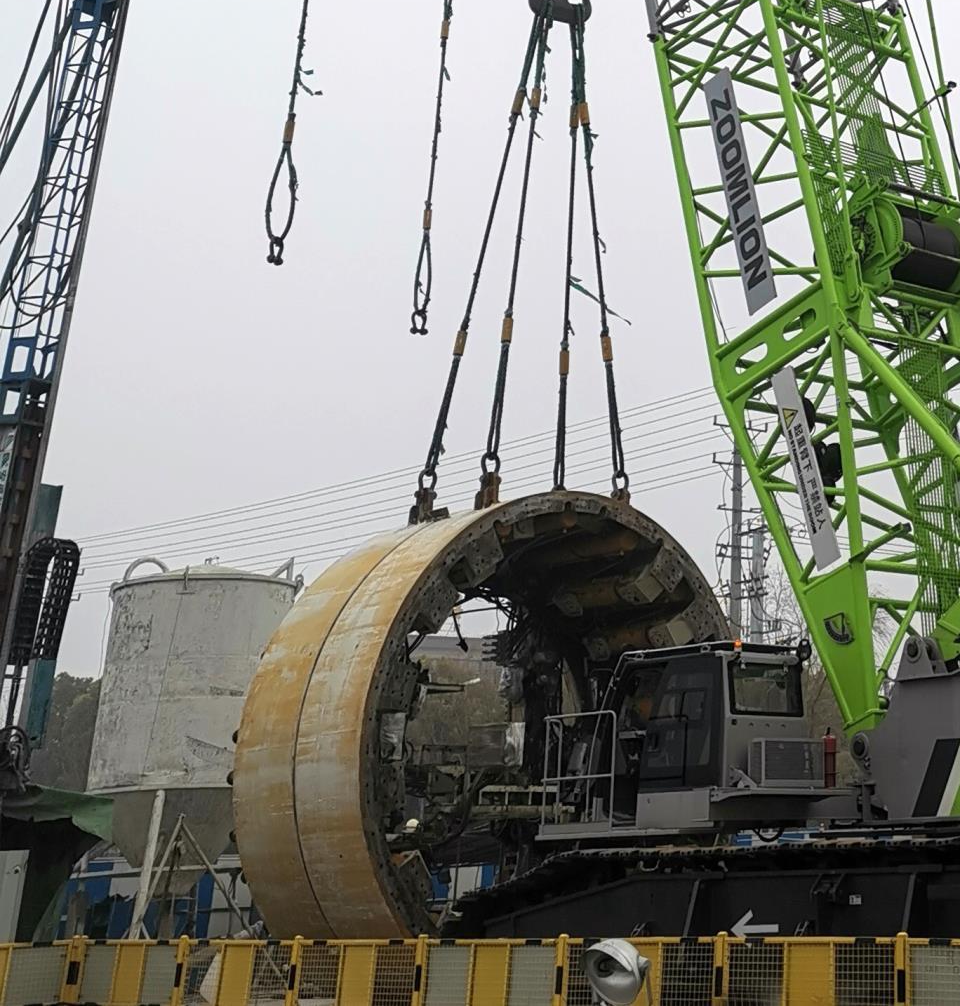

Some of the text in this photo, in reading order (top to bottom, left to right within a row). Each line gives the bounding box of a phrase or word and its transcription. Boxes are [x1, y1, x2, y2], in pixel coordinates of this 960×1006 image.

[711, 88, 767, 290] ZOOMLION
[806, 476, 826, 530] 严禁站人
